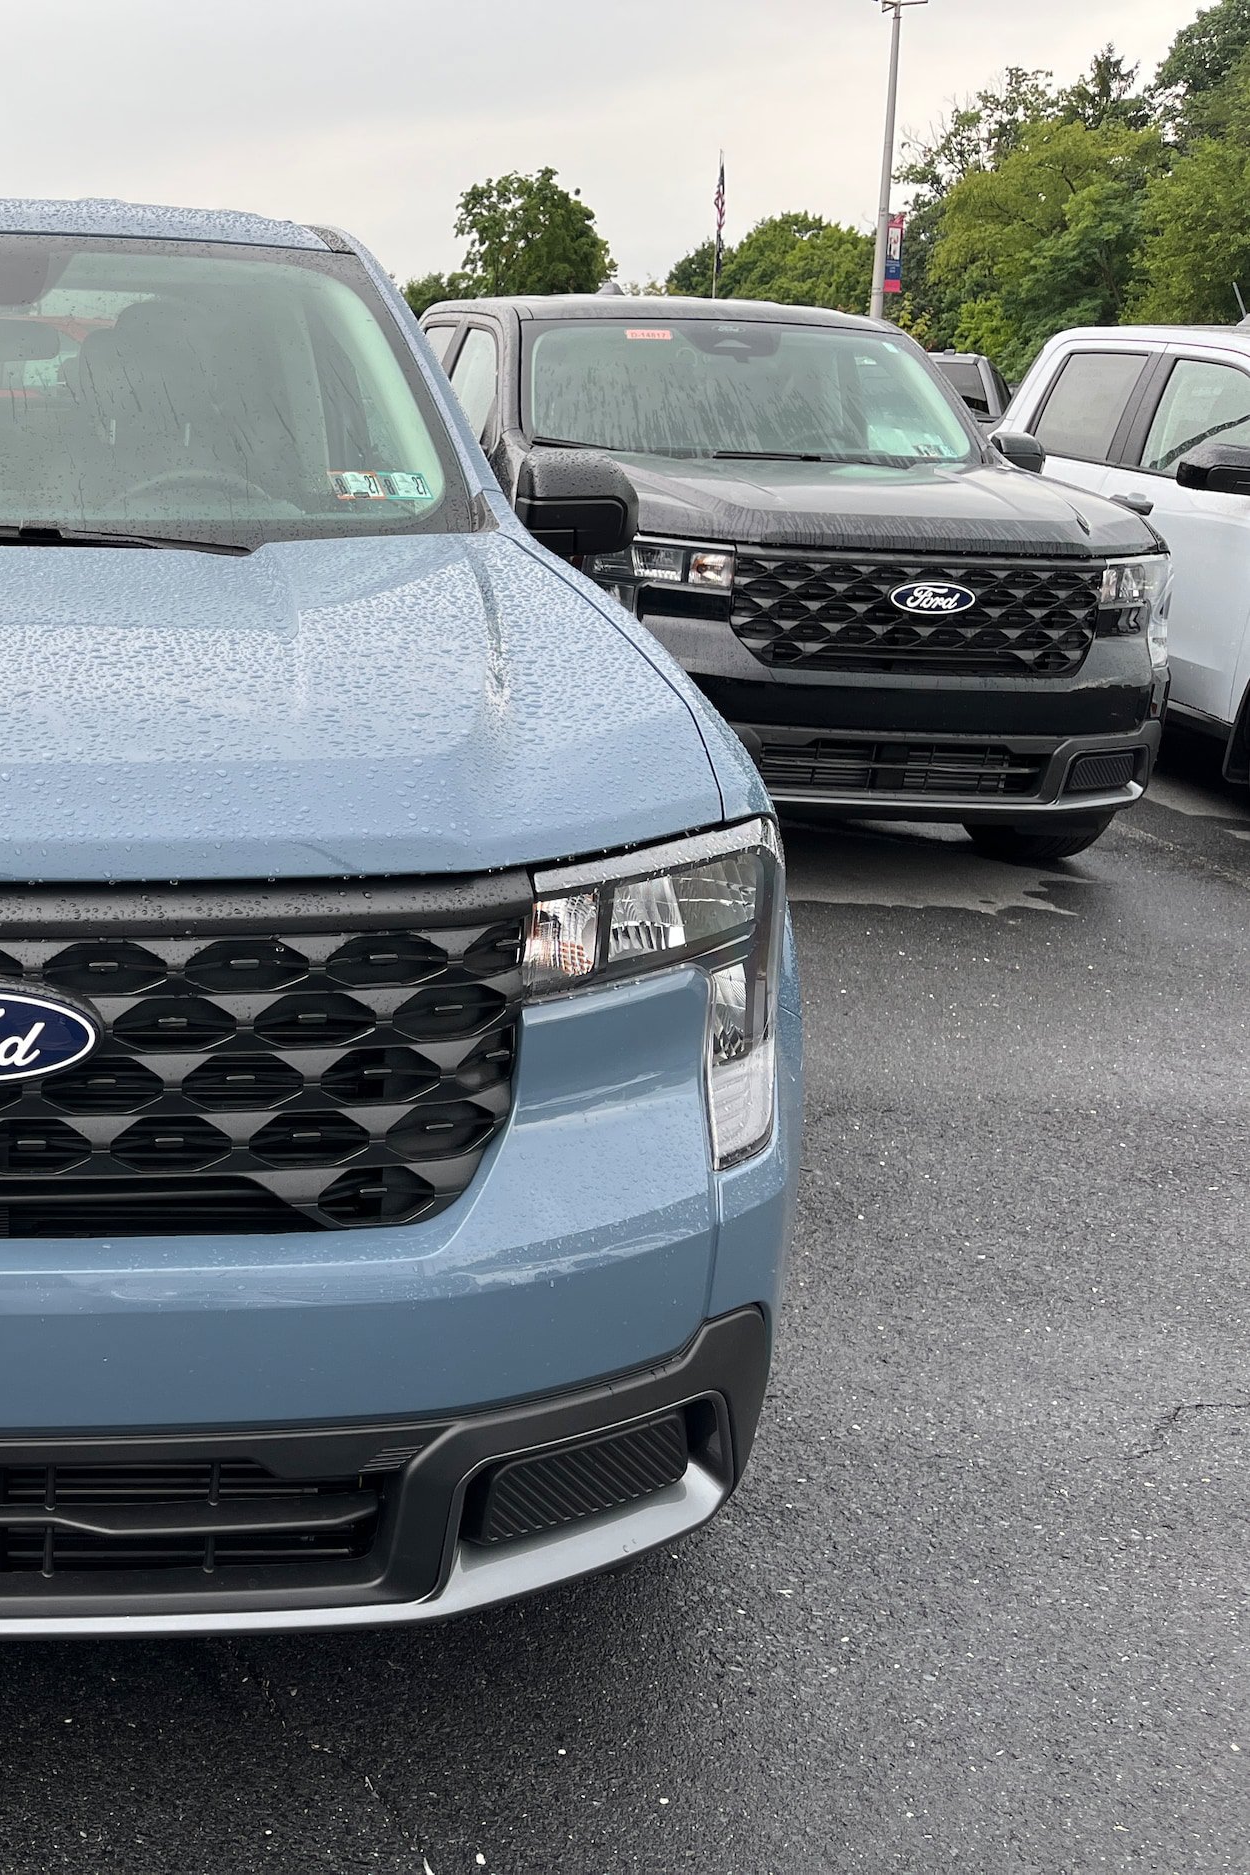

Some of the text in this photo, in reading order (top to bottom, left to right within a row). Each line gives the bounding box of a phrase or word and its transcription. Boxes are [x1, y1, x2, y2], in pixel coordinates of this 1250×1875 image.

[363, 475, 380, 495] 27
[411, 476, 427, 495] 27
[906, 586, 960, 609] Ford
